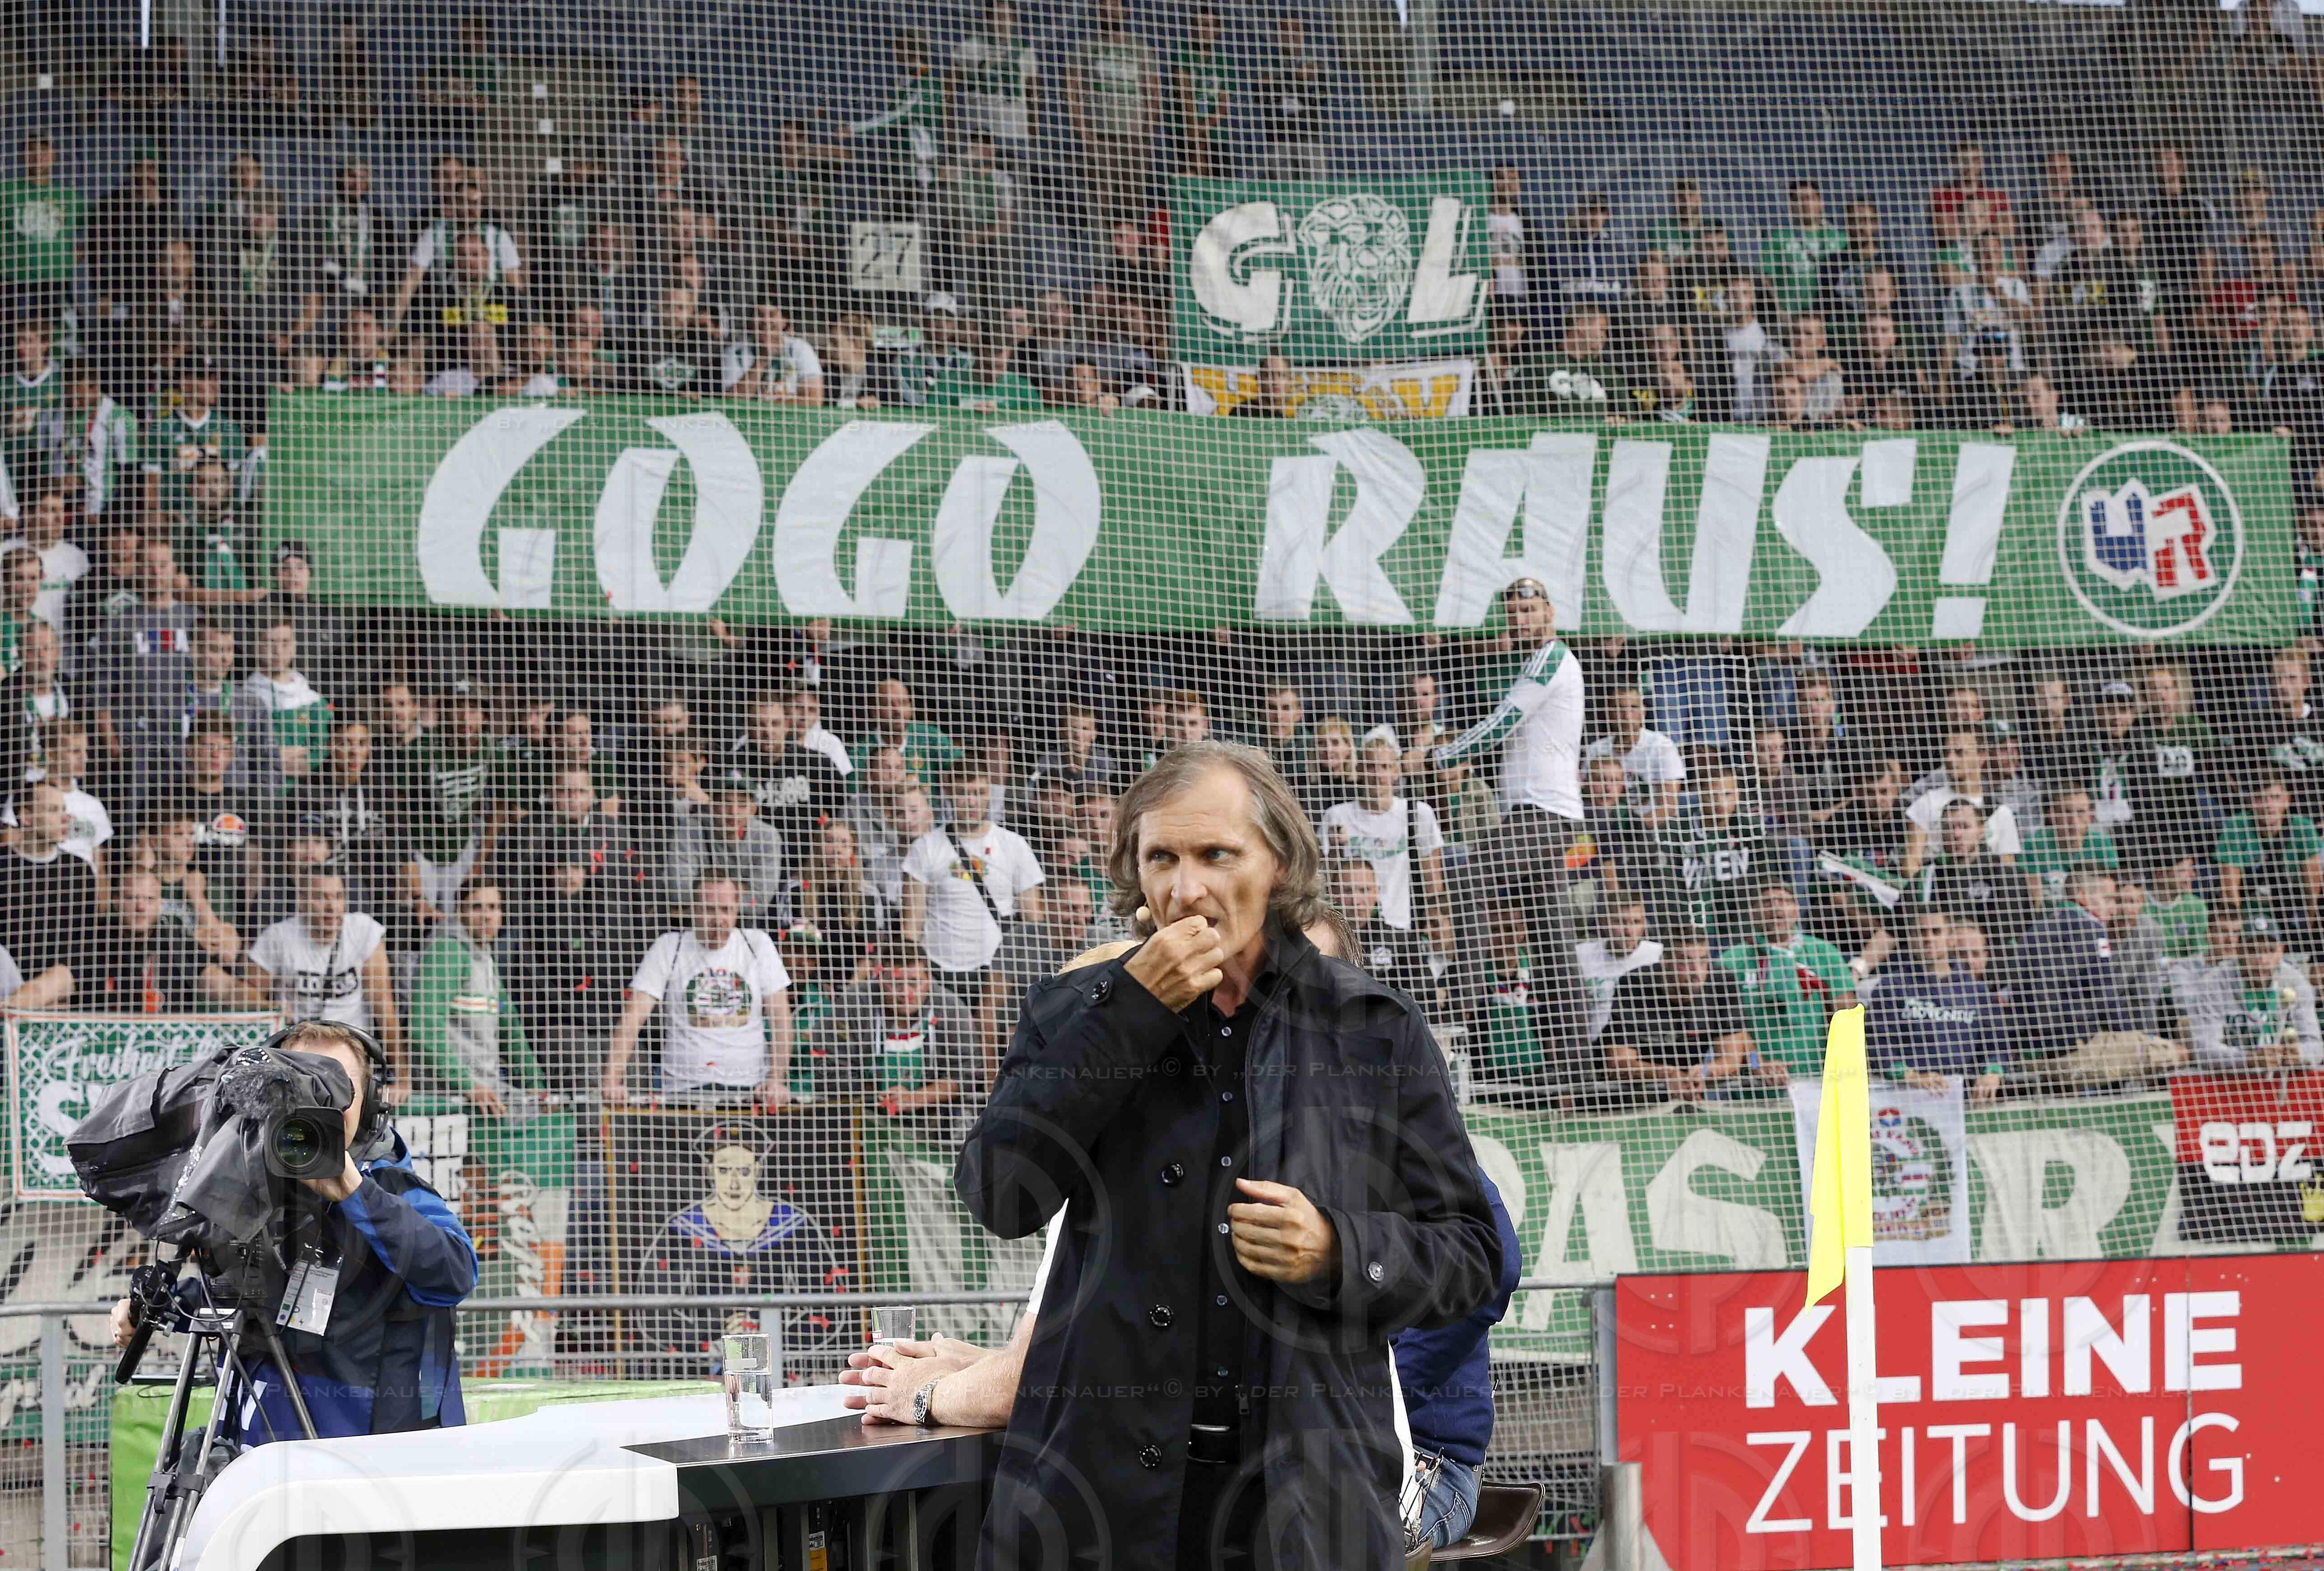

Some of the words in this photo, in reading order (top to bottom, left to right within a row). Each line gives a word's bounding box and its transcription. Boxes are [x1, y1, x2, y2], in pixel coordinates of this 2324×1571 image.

[859, 229, 913, 279] 27
[418, 407, 1101, 619] GOGO
[1253, 426, 2016, 638] RAUS!
[1746, 1413, 2244, 1534] ZEITUNG
